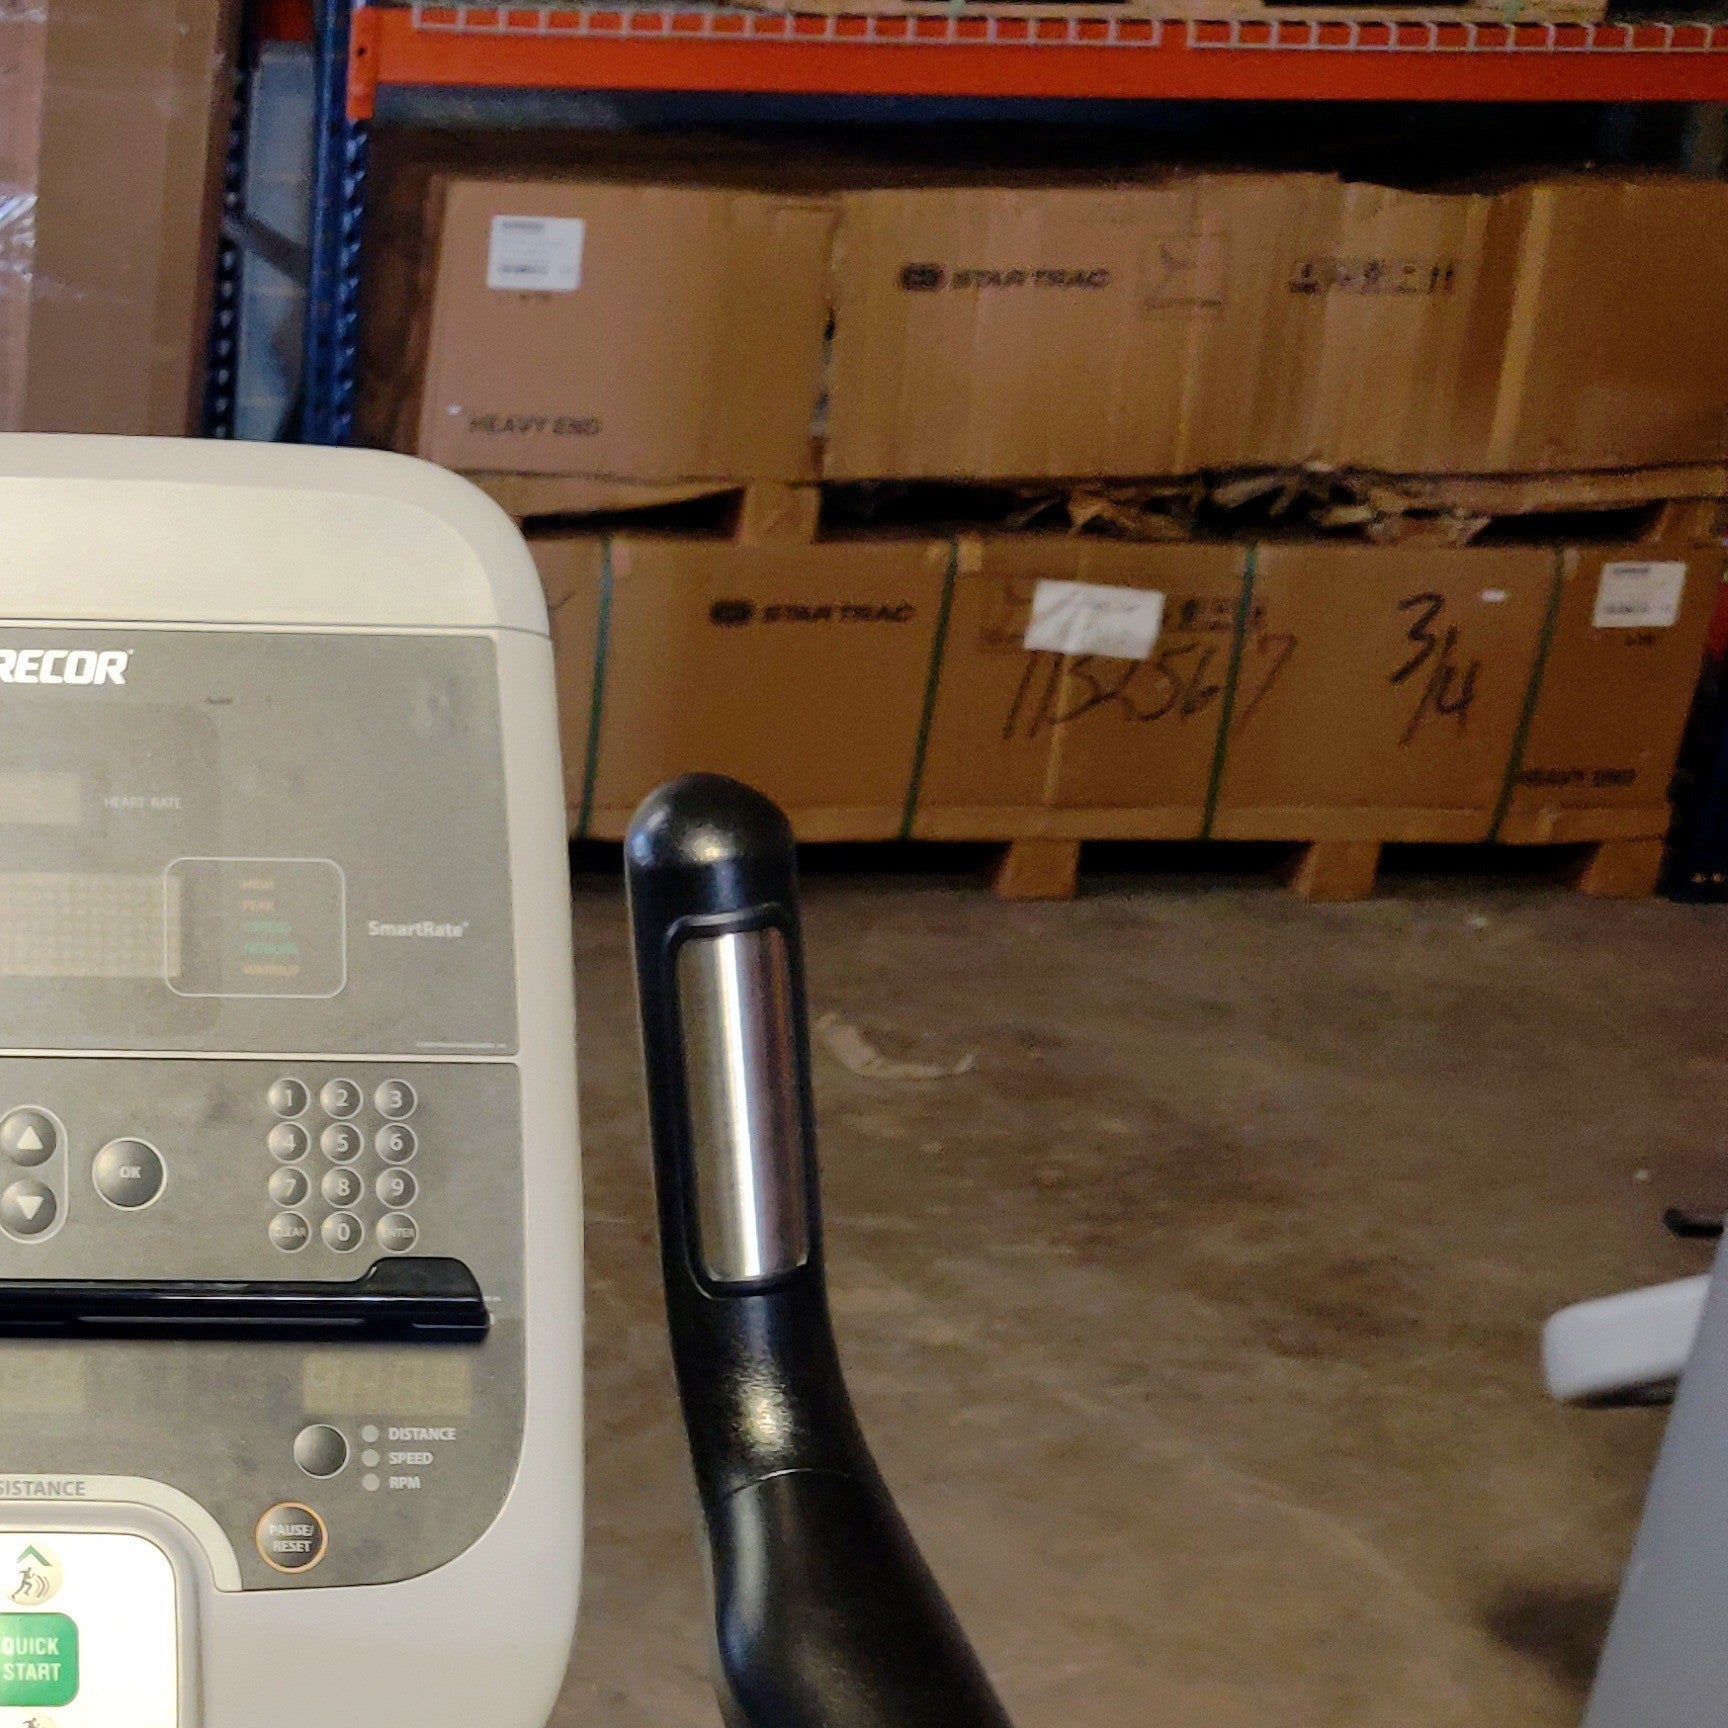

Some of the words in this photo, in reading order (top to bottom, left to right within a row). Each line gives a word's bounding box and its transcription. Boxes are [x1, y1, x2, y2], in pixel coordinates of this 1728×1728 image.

[469, 414, 550, 435] HEAVY
[552, 416, 602, 437] END
[284, 1089, 293, 1107] 1
[336, 1088, 349, 1107] 2
[389, 1090, 402, 1108] 3
[283, 1134, 297, 1151] 4
[335, 1134, 349, 1152] 5
[390, 1134, 403, 1151] 6
[119, 1166, 142, 1179] OK
[283, 1179, 296, 1197] 7
[337, 1180, 350, 1196] 8
[393, 1178, 404, 1195] 9
[337, 1222, 350, 1242] 0
[388, 1427, 457, 1441] DISTANCE
[388, 1452, 434, 1465] SPEED
[389, 1476, 421, 1489] RPM
[272, 1540, 313, 1553] RESET
[1, 1636, 60, 1656] QUICK
[2, 1662, 62, 1682] START
